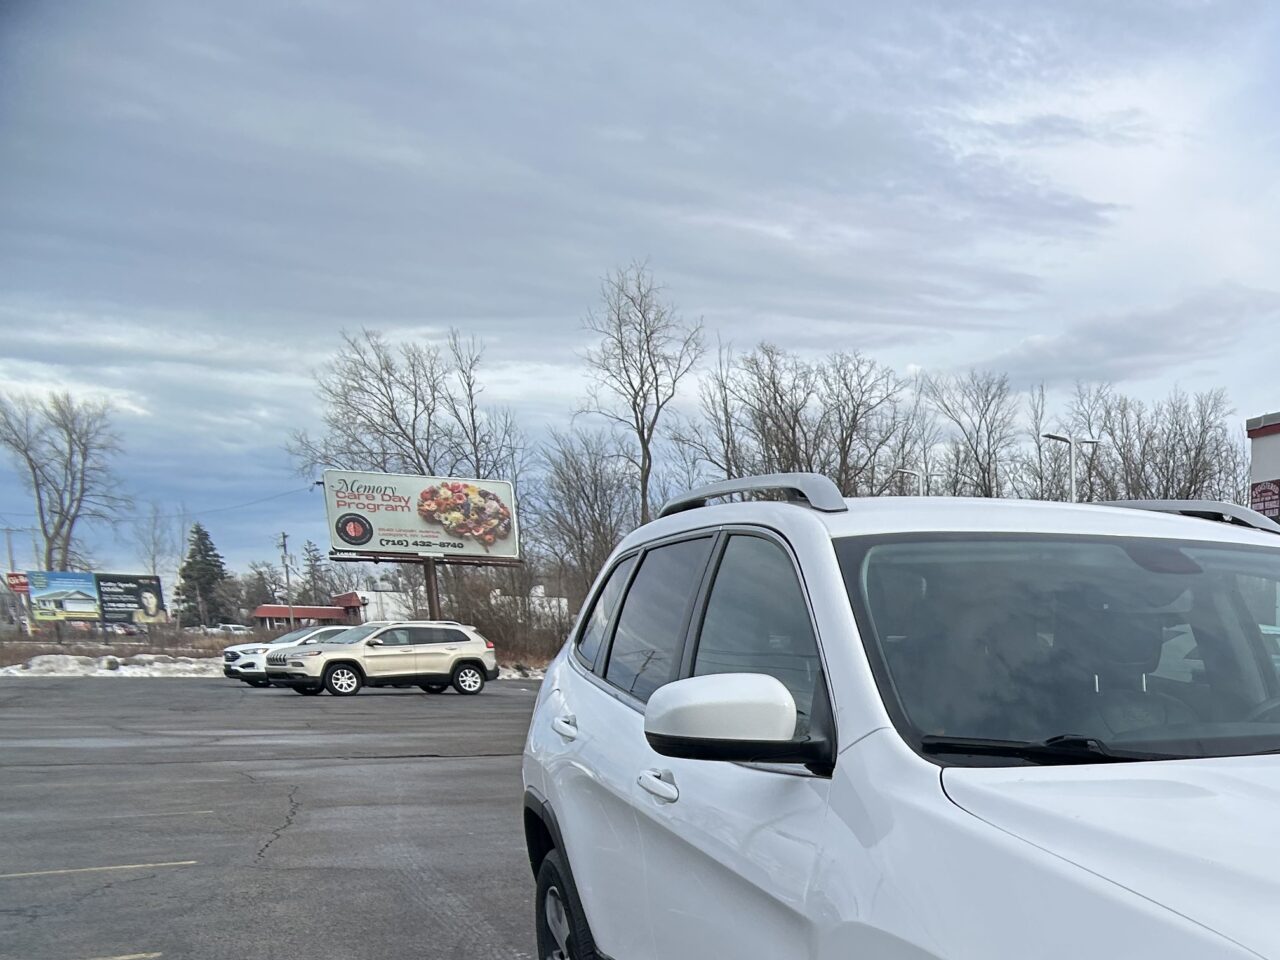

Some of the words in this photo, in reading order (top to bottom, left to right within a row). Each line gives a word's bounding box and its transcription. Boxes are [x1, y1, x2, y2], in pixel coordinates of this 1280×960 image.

[330, 479, 397, 496] Memory
[335, 490, 375, 501] Care
[381, 493, 411, 506] Day
[336, 500, 411, 512] Program
[379, 538, 409, 548] (716)
[411, 540, 464, 549] 432-8740
